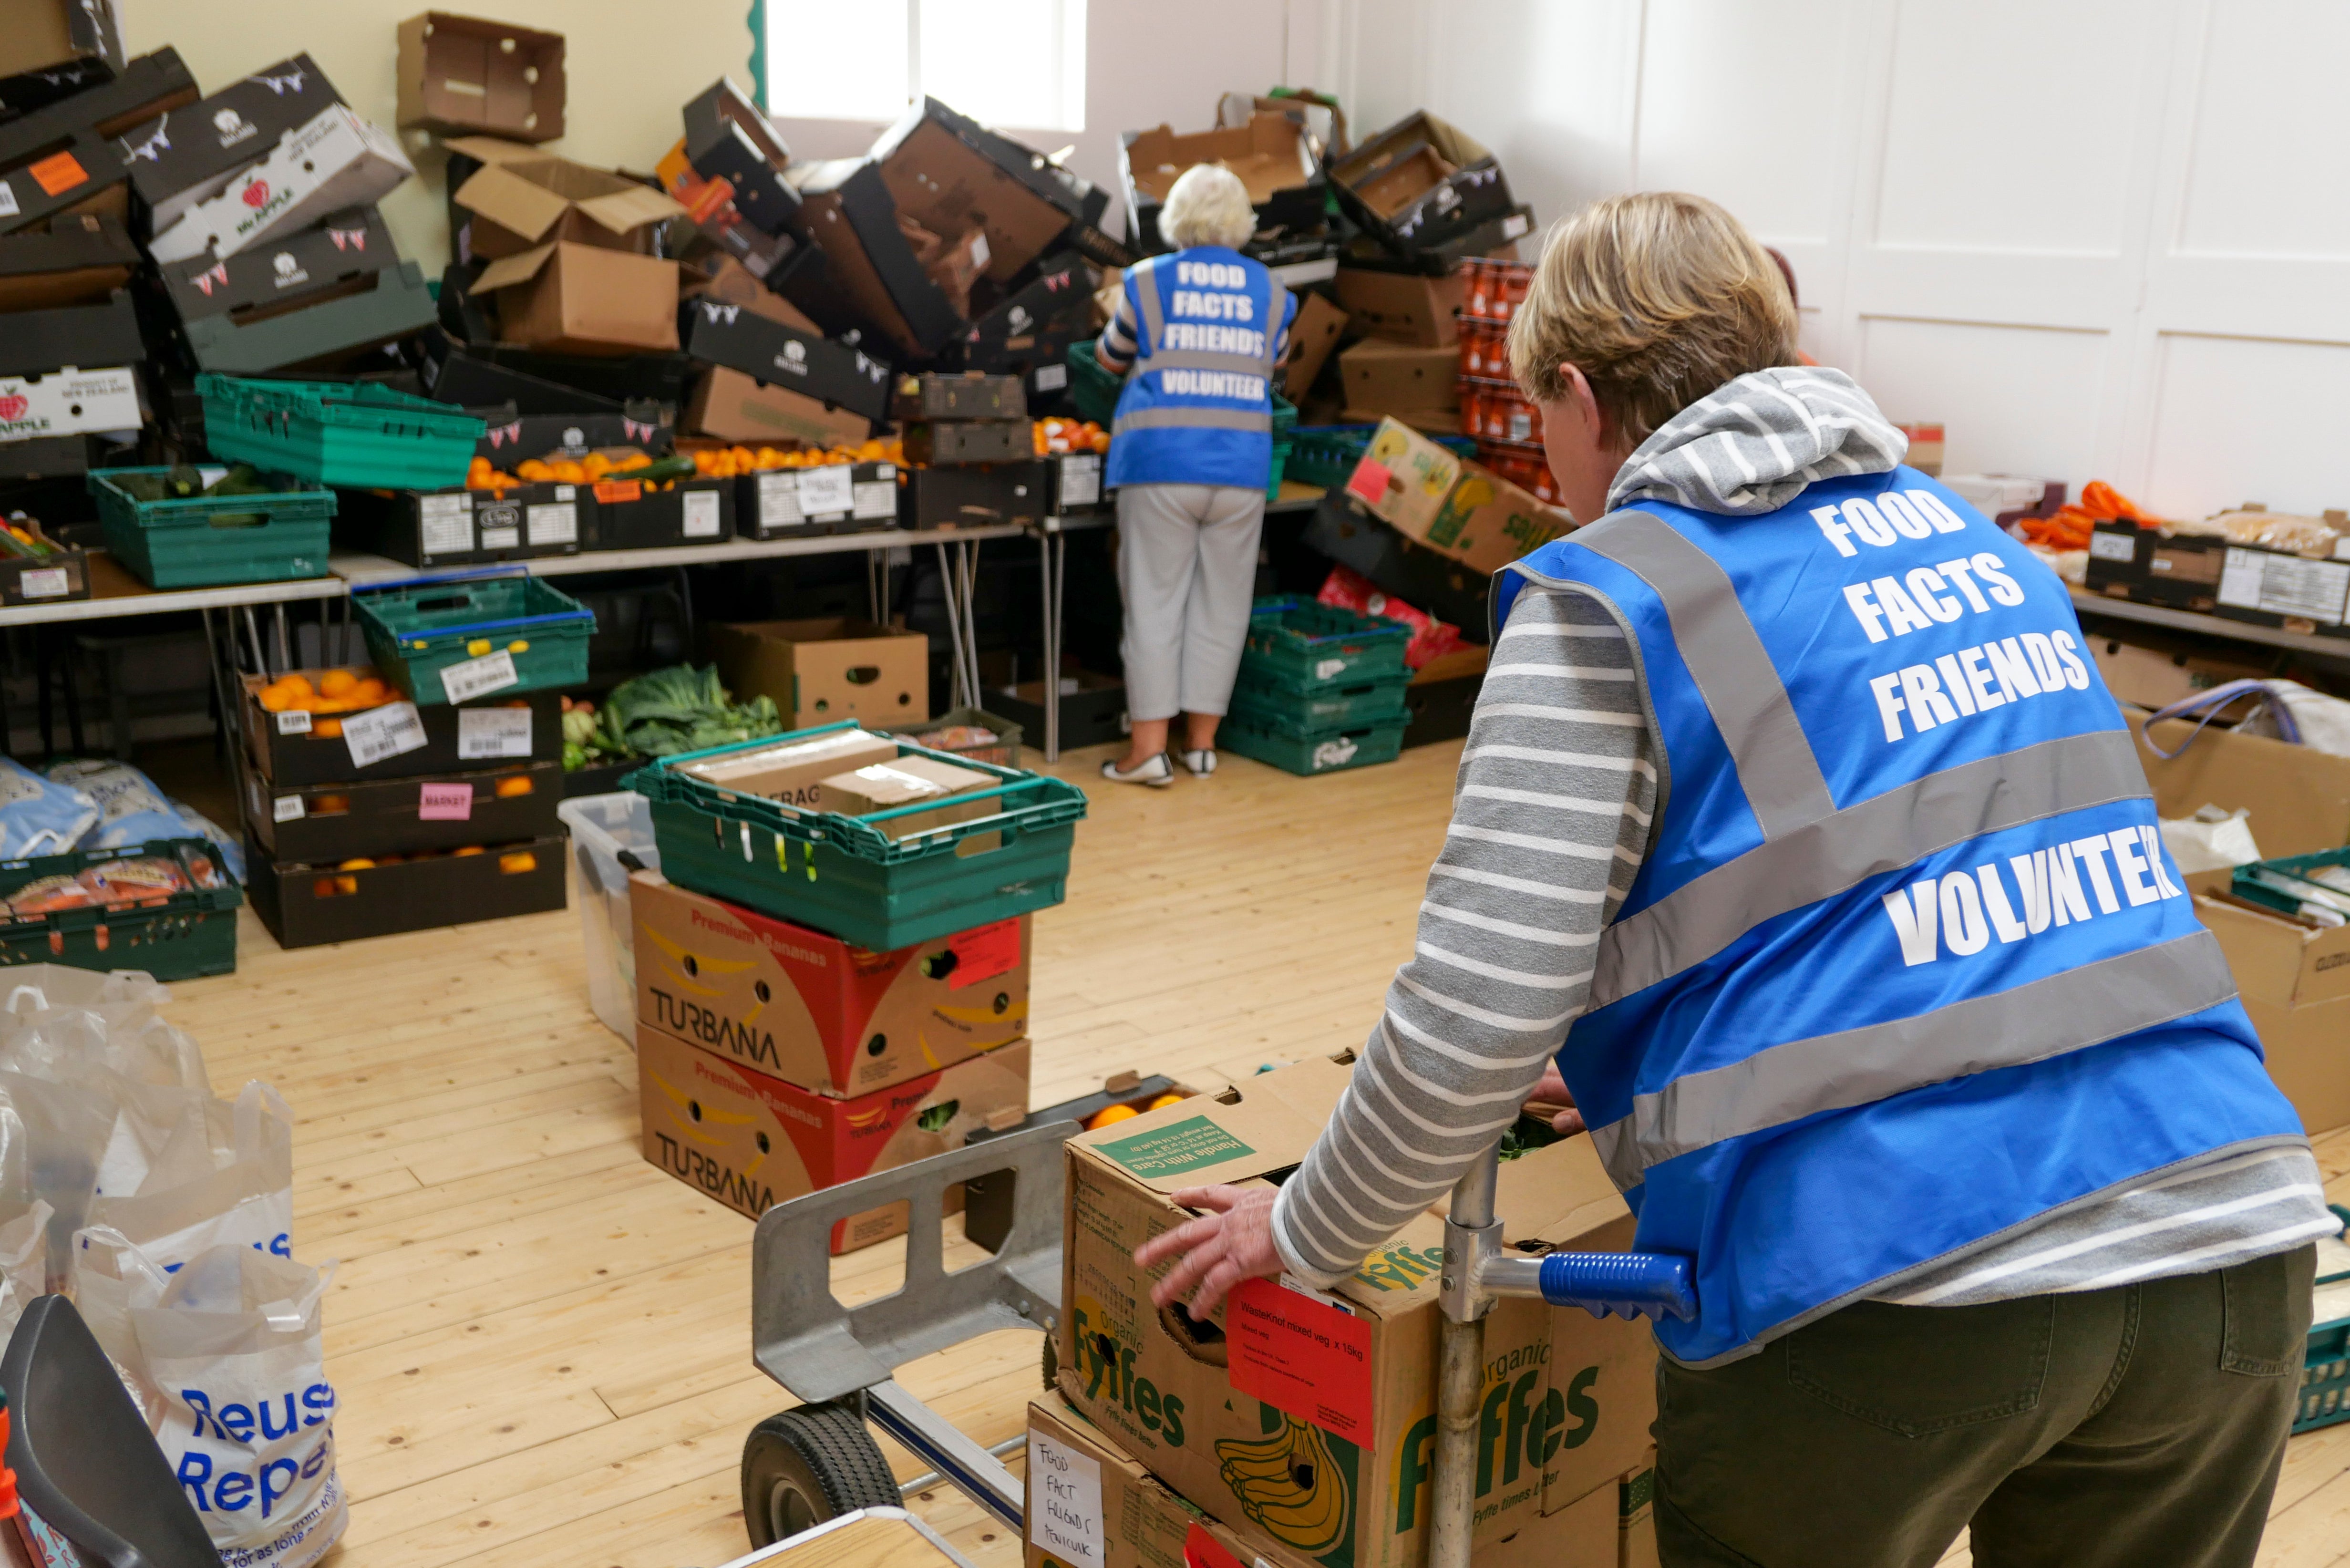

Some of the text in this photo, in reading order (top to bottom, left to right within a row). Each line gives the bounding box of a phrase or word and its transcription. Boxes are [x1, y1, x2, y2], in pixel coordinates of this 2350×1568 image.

[1177, 261, 1247, 289] FOOD
[1172, 290, 1254, 322] FACTS
[1165, 322, 1265, 358] FRIENDS
[1162, 369, 1265, 401] VOLUNTEER
[1809, 489, 1966, 558] FOOD
[1843, 552, 2025, 644] FACTS
[1869, 629, 2090, 743] FRIENDS
[691, 908, 827, 968] Premium Bananas
[649, 986, 781, 1070] TURBANA
[695, 1061, 823, 1129] Premium Bananas
[656, 1130, 776, 1216] TURBANA
[1133, 1140, 1242, 1171] Handle With Care
[1353, 1246, 1443, 1292] fyffe
[1101, 1310, 1144, 1355] Organic
[1241, 1300, 1363, 1362] WasteKnot mixed veg x 15kg
[182, 1383, 335, 1444] Reus
[1039, 1443, 1069, 1472] FOOD
[1396, 1366, 1599, 1535] fffes
[1047, 1475, 1077, 1500] FACT
[274, 1529, 305, 1554] long
